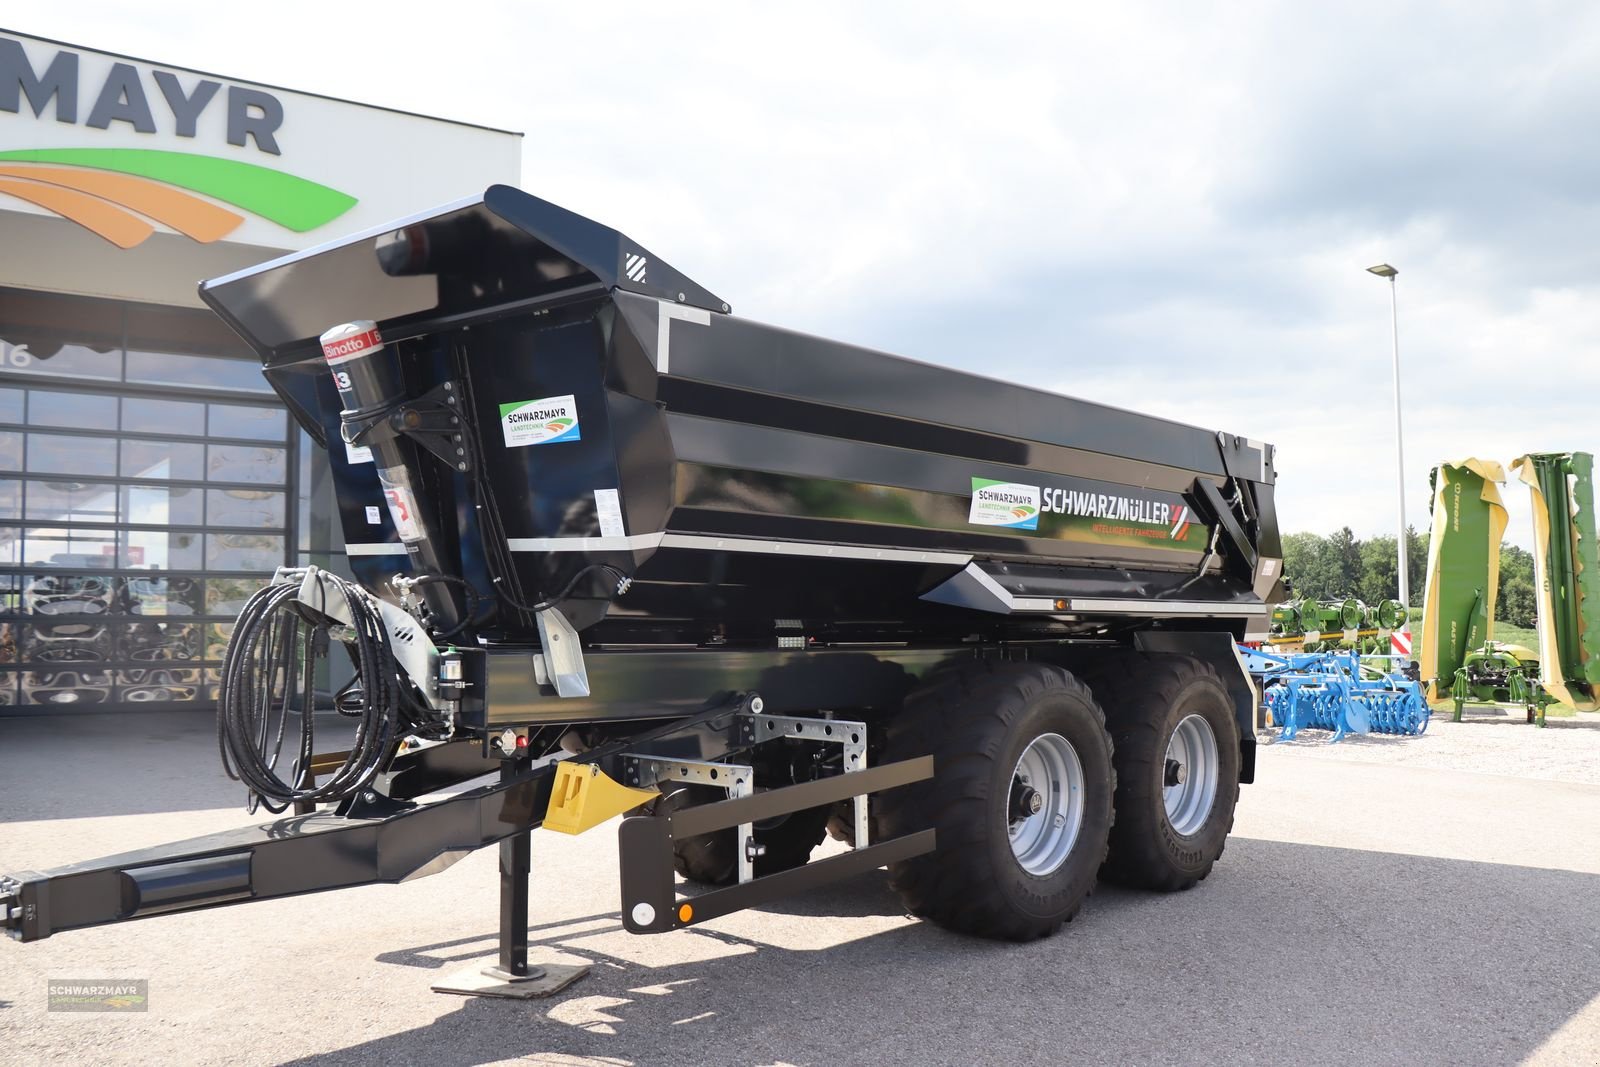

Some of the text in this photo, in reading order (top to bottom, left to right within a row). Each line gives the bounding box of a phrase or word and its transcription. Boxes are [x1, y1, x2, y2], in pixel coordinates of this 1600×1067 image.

[0, 37, 284, 156] MAYR
[324, 340, 364, 358] Binotto
[508, 408, 567, 424] SCHWARZMAYR
[978, 490, 1032, 505] SCHWARZMAYR
[1041, 487, 1170, 525] SCHWARZMÜLLER
